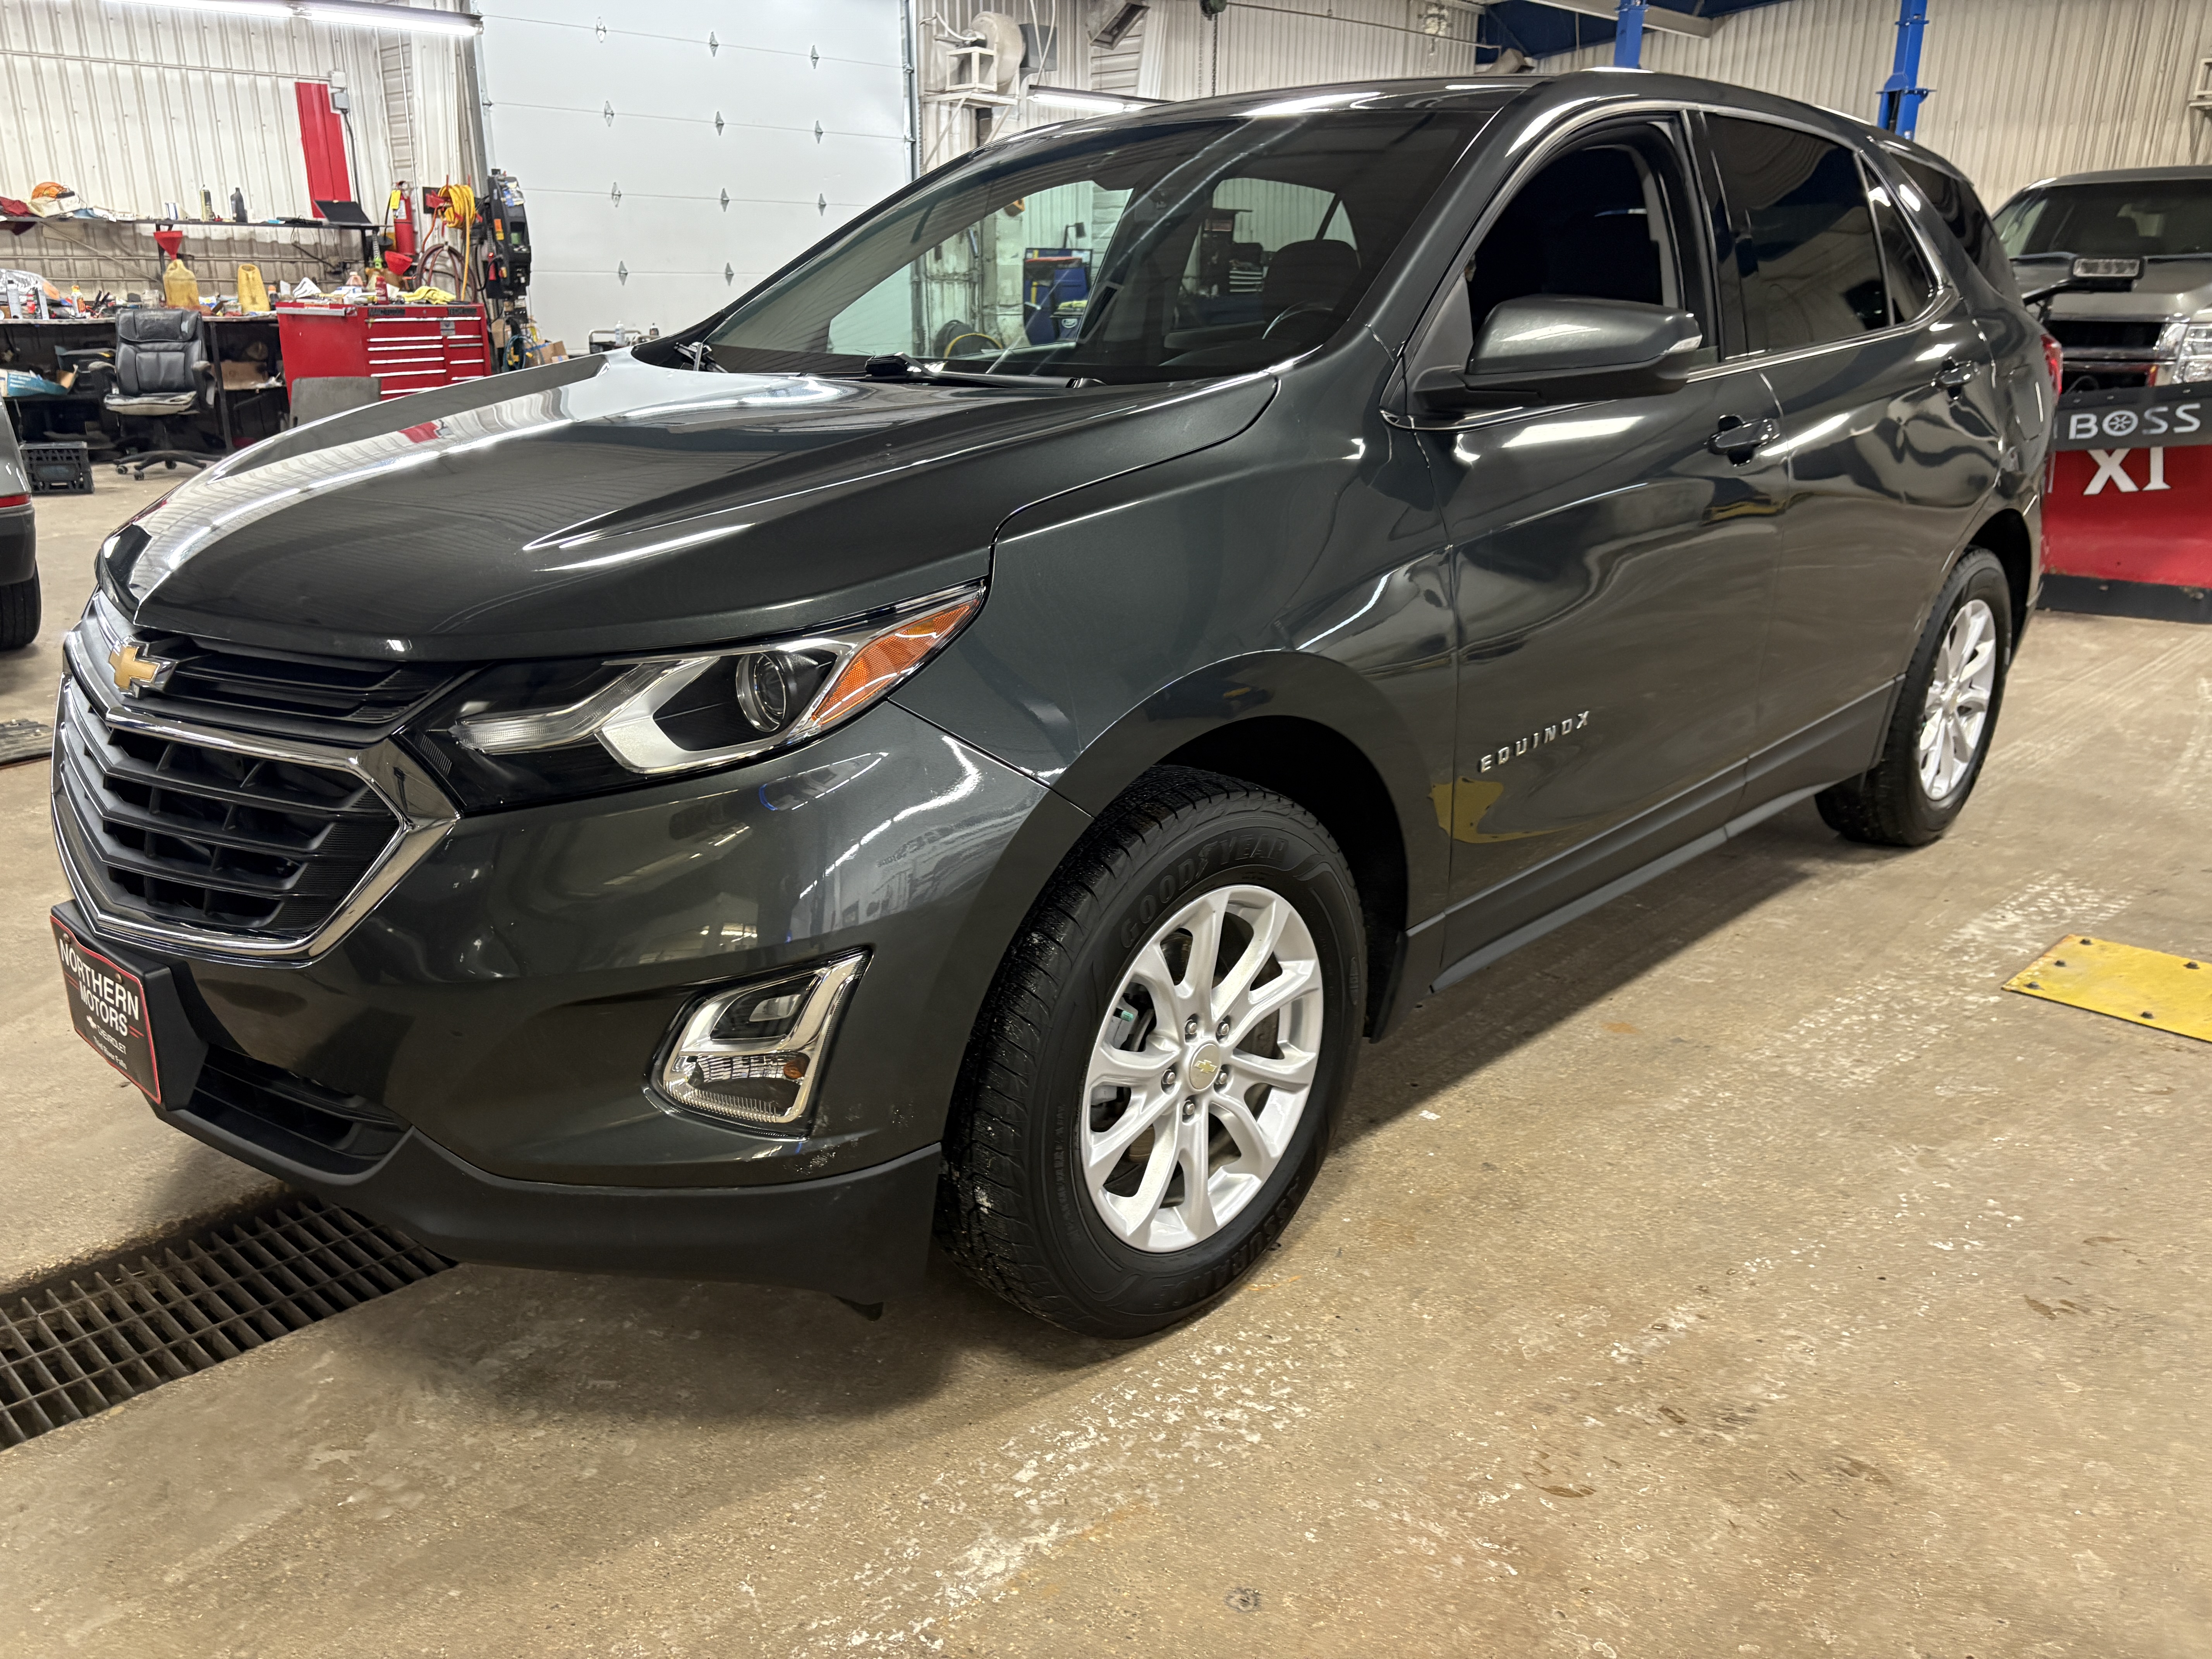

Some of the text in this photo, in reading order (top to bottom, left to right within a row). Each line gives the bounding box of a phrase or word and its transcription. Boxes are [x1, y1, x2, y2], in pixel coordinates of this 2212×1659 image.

[2069, 403, 2201, 440] BOSS
[1480, 710, 1590, 773] EQUINOX
[1120, 834, 1289, 948] GOODYEAR
[59, 938, 139, 1020] NORTHERN
[79, 980, 129, 1037] MOTORS
